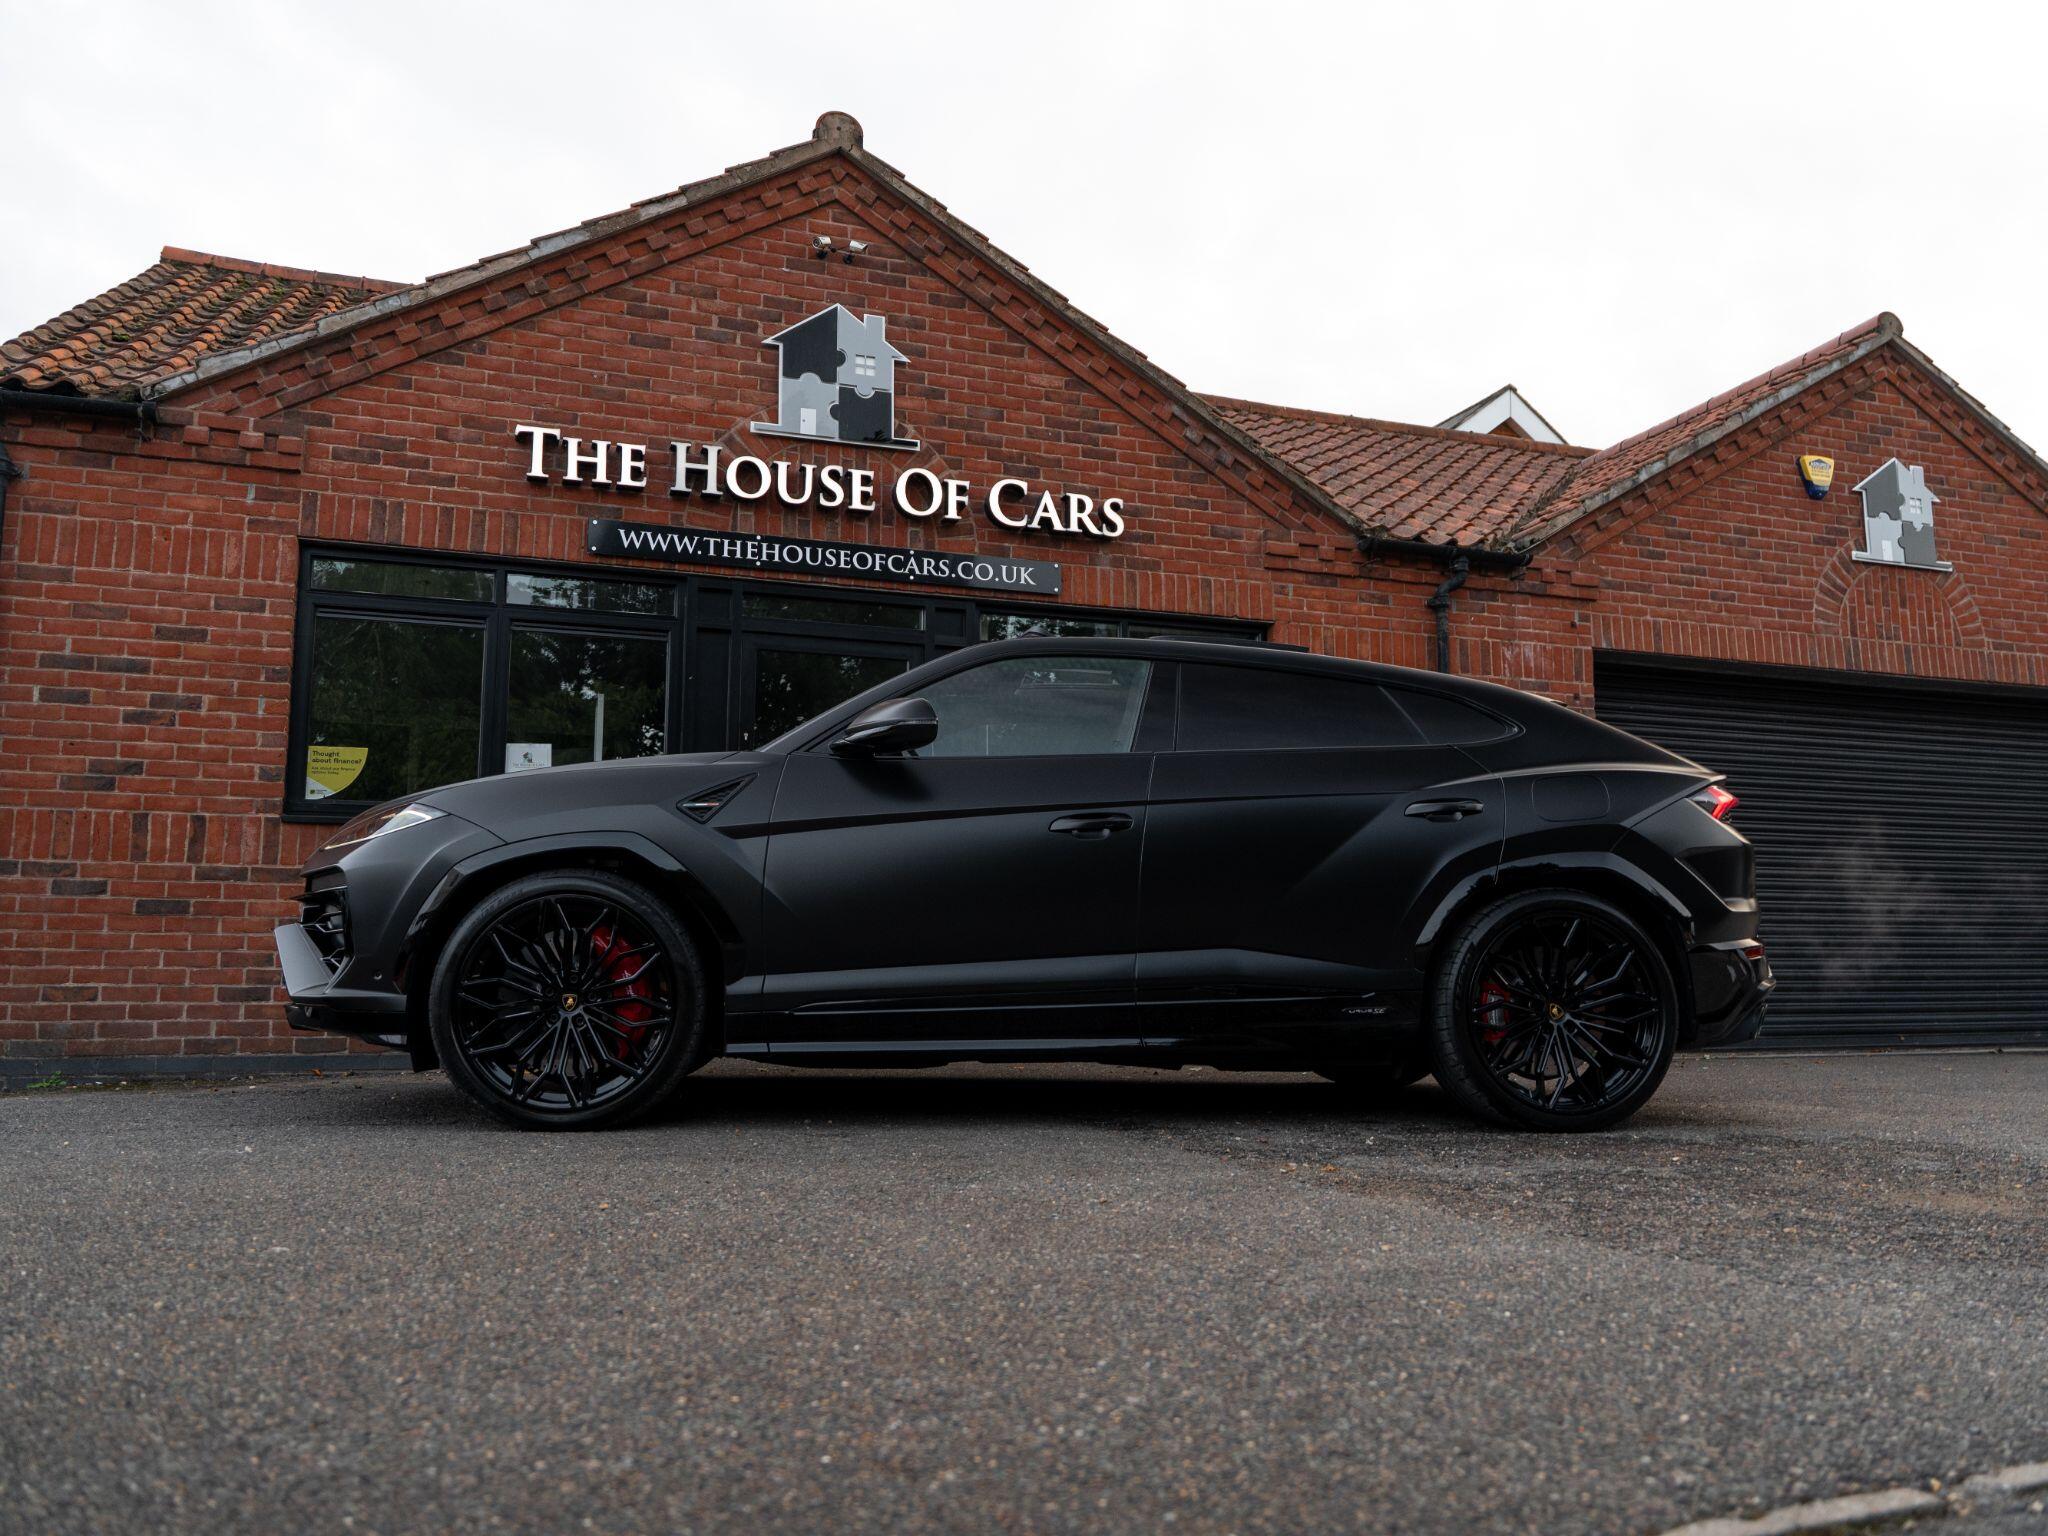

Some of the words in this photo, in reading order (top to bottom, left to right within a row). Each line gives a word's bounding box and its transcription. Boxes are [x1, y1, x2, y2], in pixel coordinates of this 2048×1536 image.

[514, 423, 649, 488] THE
[670, 440, 877, 512] HOUSE
[895, 467, 970, 520] OF
[987, 478, 1125, 538] CARS
[617, 527, 1038, 586] WWW.THEHOUSEOFCARS.CO.UK
[312, 750, 340, 758] Thought
